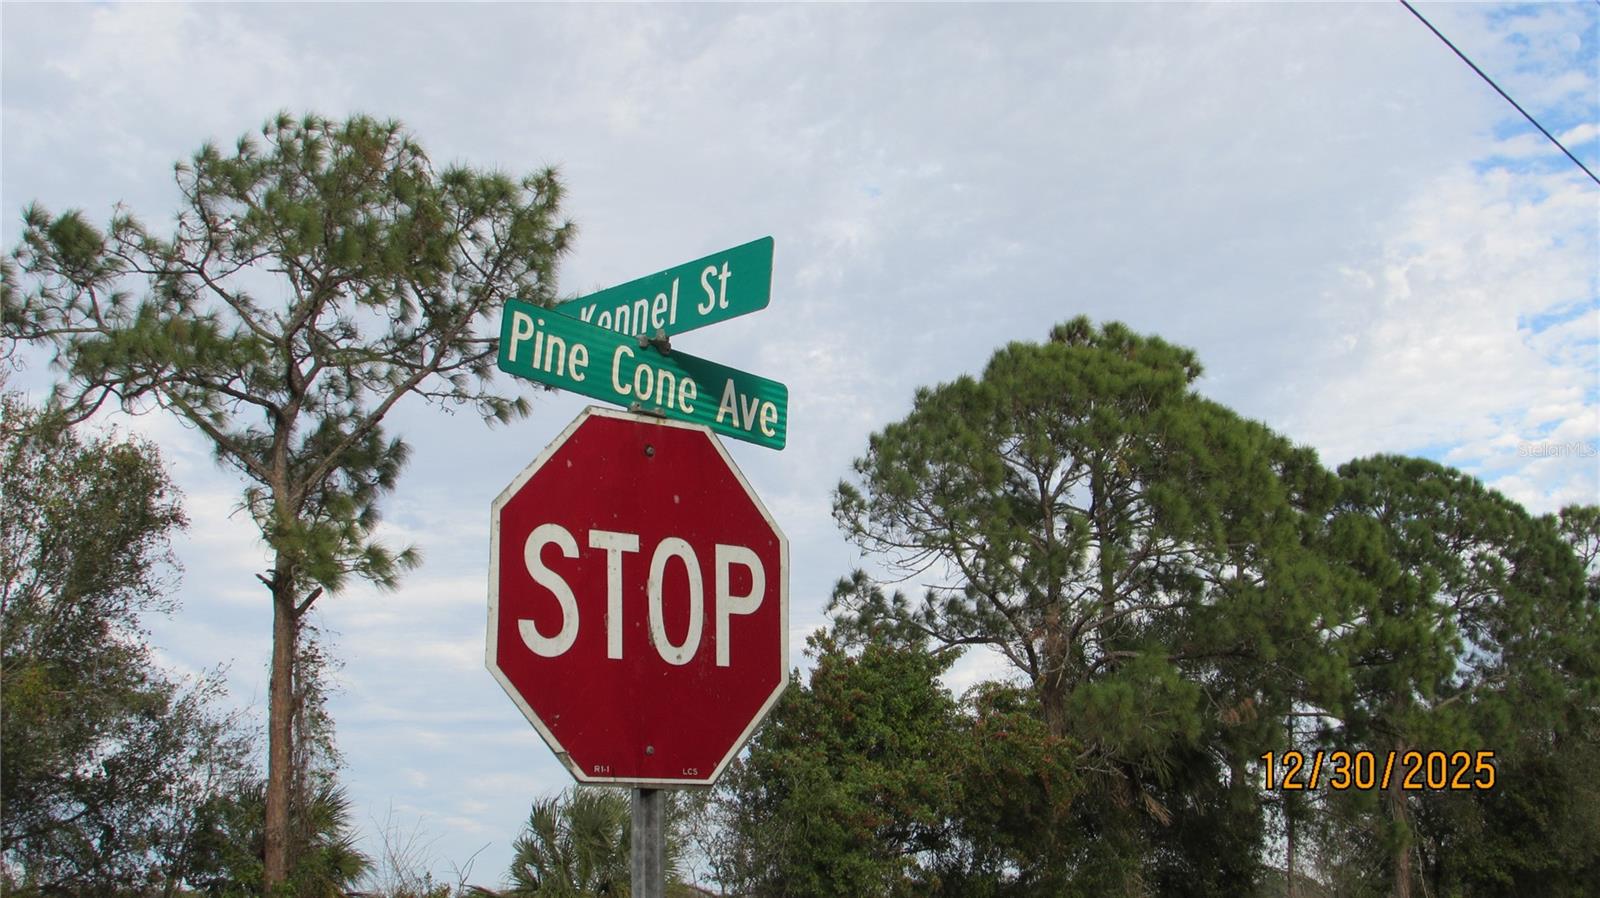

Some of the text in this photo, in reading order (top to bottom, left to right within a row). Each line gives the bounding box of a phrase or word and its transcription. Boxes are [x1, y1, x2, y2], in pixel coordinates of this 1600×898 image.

[697, 261, 732, 317] St
[508, 311, 778, 438] Pine Cone Ave
[517, 522, 766, 668] STOP
[593, 764, 610, 773] R1-1
